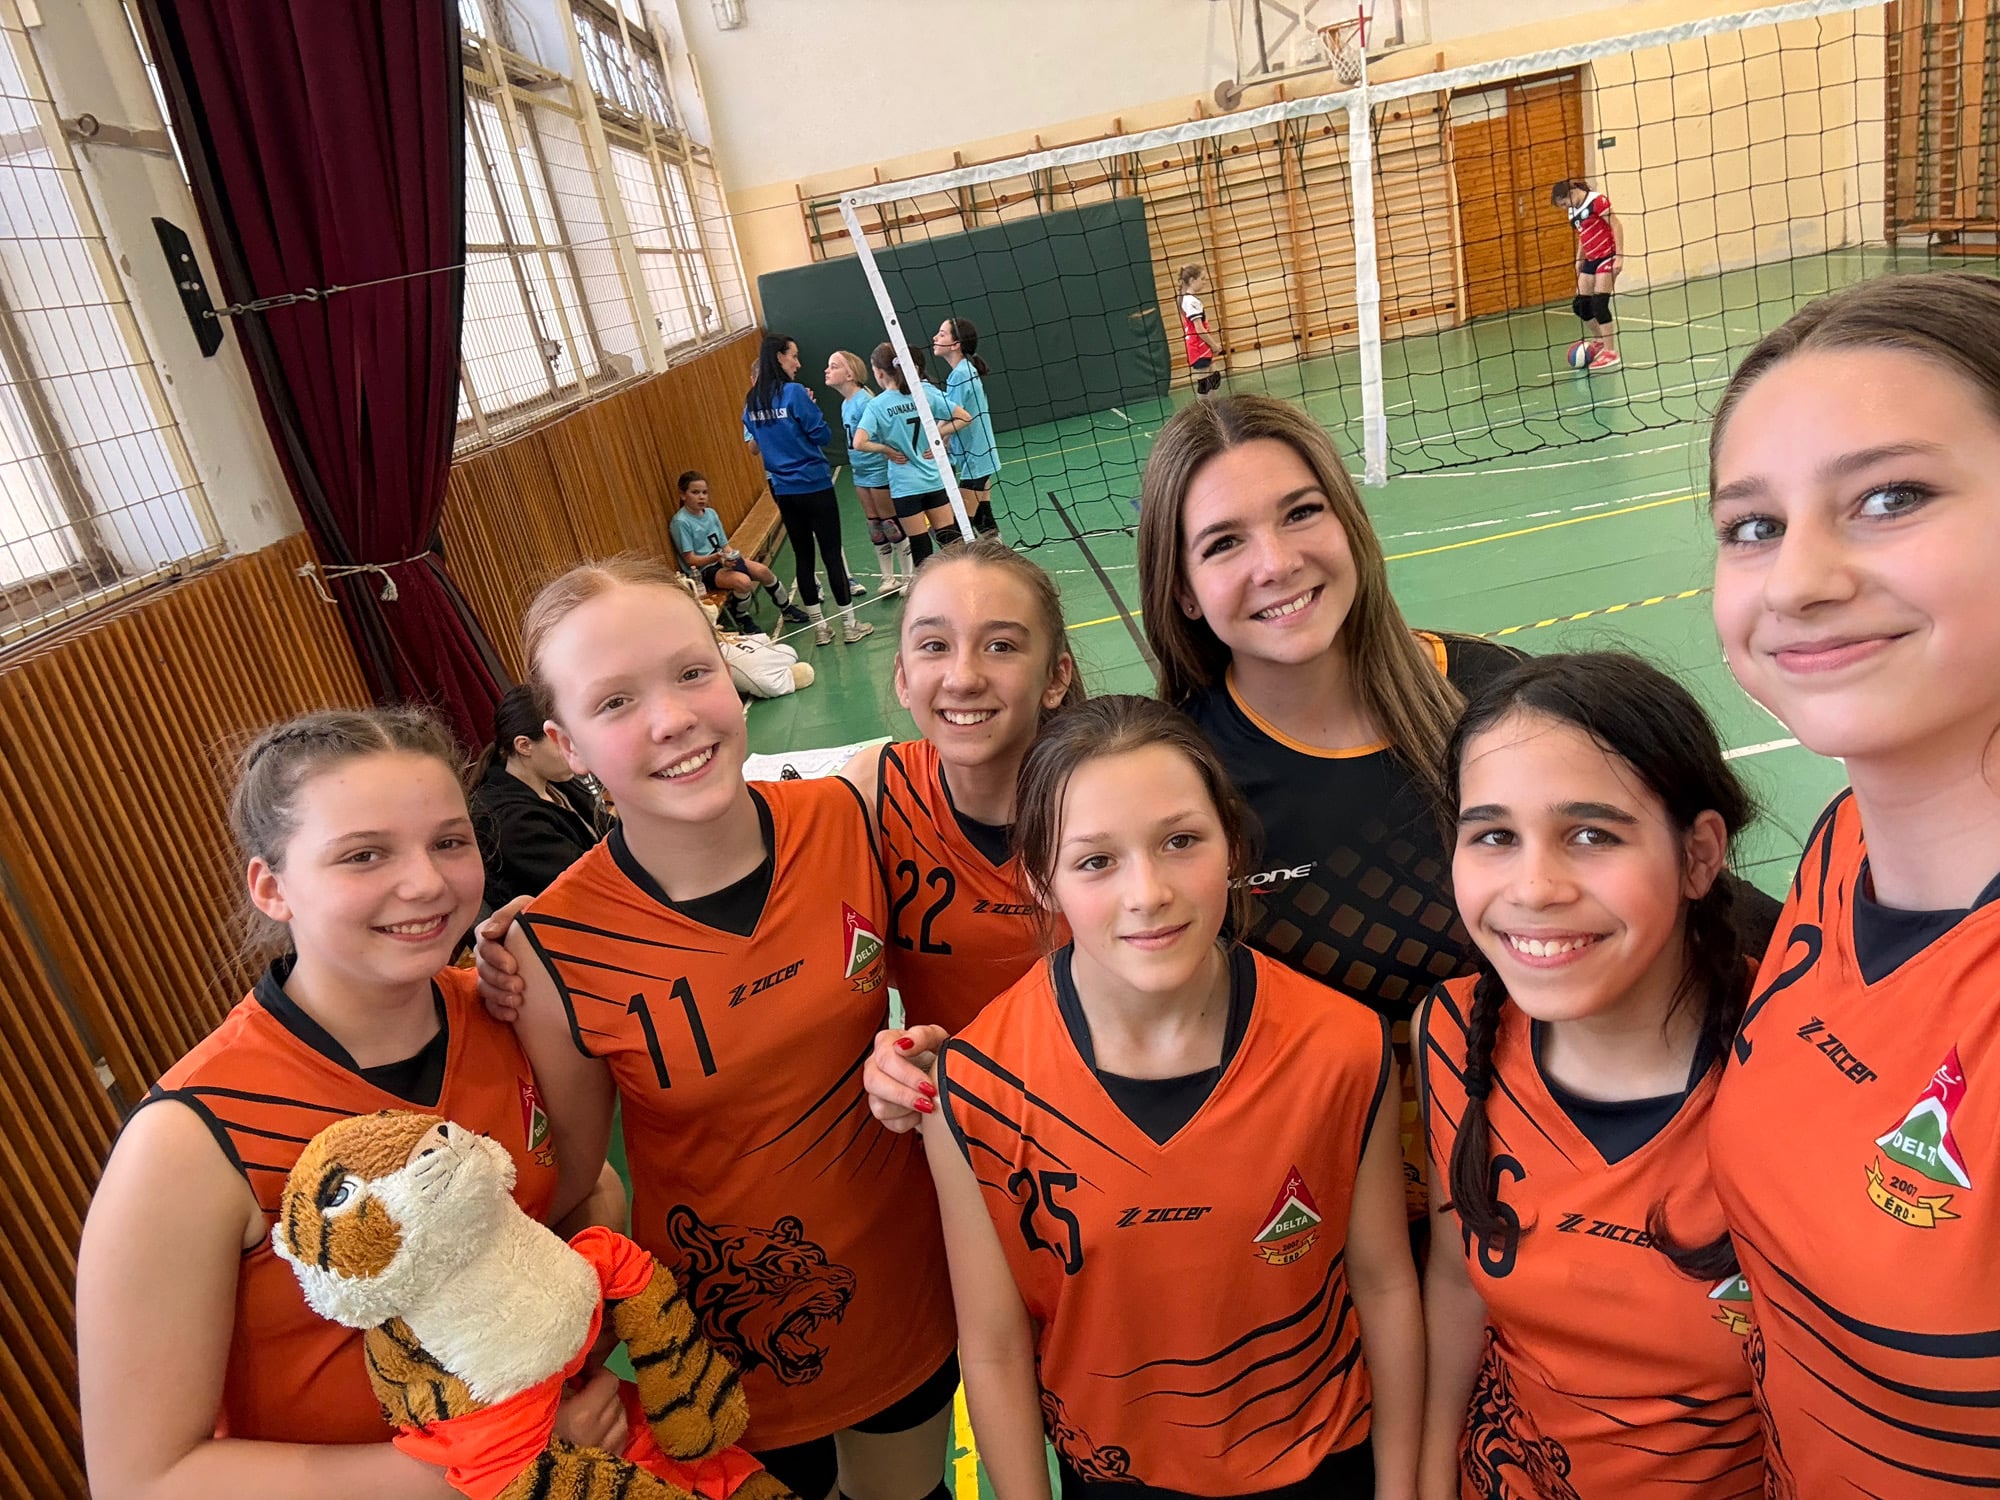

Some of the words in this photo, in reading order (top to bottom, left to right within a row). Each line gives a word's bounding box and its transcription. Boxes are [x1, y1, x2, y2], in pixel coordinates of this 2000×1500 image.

[906, 416, 920, 456] 7
[893, 860, 956, 955] 22
[855, 942, 878, 963] DELTA
[1734, 923, 1823, 1066] 2
[626, 976, 718, 1090] 11
[1892, 1131, 1938, 1167] DELTA
[1007, 1167, 1085, 1276] 25
[1275, 1215, 1309, 1234] DELTA
[1883, 1196, 1910, 1220] ÉRD
